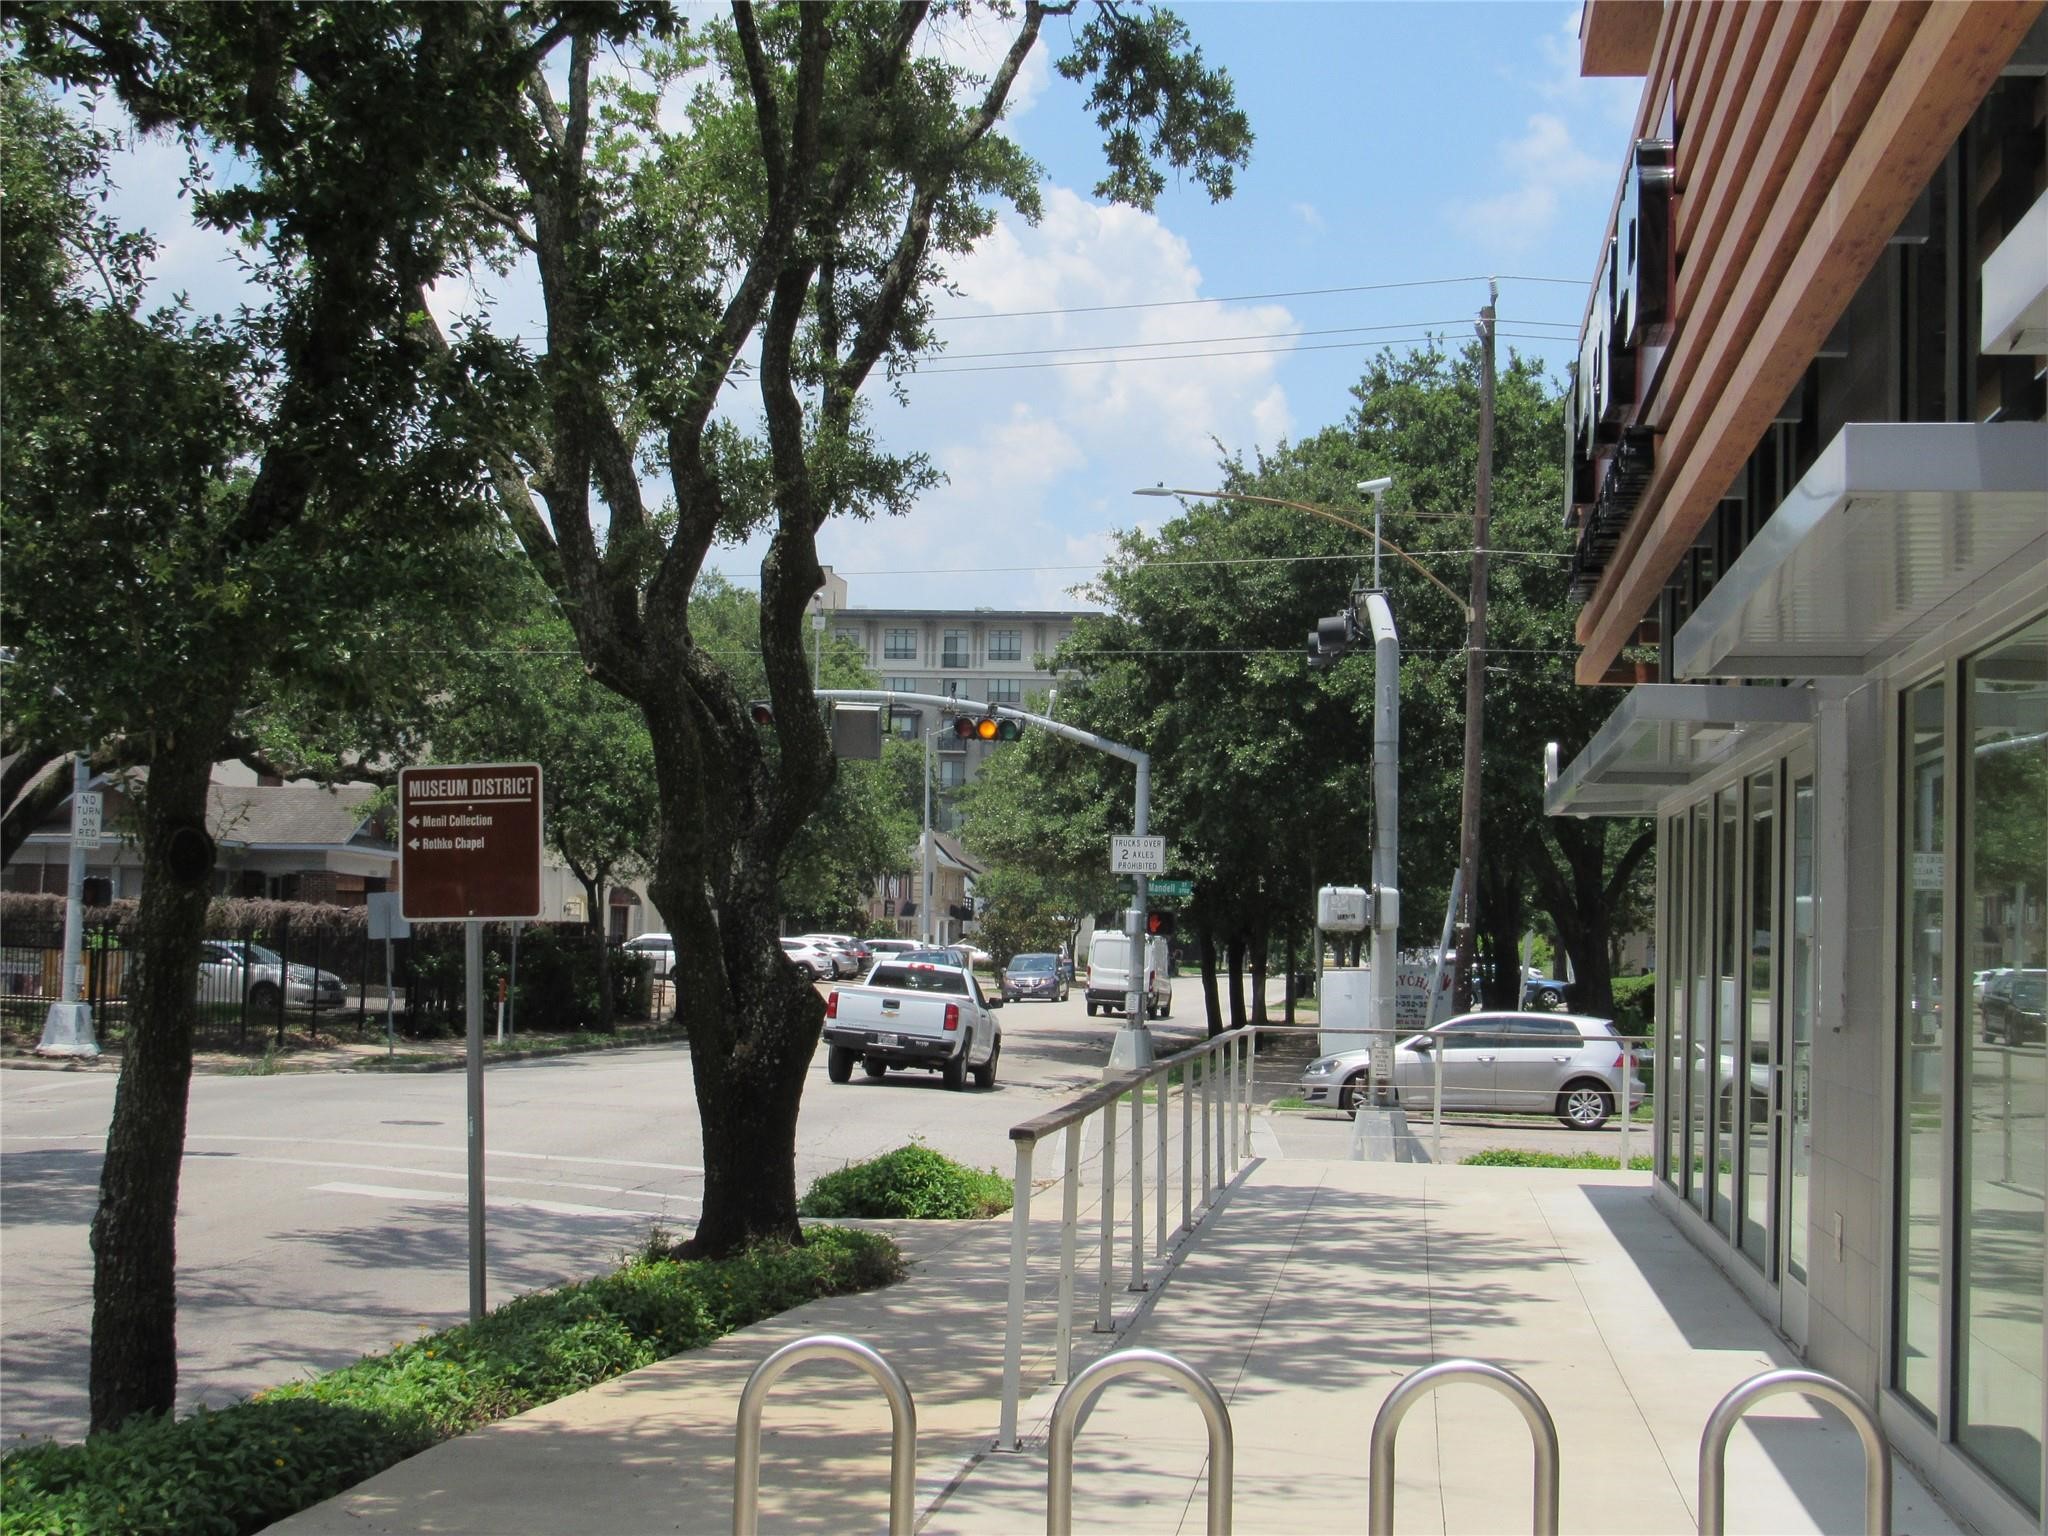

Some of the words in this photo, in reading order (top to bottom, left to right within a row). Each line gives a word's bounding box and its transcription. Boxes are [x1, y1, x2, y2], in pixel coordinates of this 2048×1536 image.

[409, 779, 468, 798] MUSEUM
[472, 777, 534, 796] DISTRICT
[82, 795, 96, 805] NO
[77, 806, 101, 815] TURN
[82, 817, 95, 826] ON
[422, 815, 447, 828] Menil
[449, 814, 493, 827] Collection
[79, 829, 97, 838] RED
[422, 837, 453, 850] Rothko
[455, 836, 485, 851] Chapel
[1115, 839, 1140, 848] TRUCKS
[1143, 840, 1161, 848] OVER
[1121, 849, 1129, 860] 2
[1132, 850, 1154, 859] AXLES
[1118, 862, 1157, 870] PROHIBITED
[1148, 882, 1176, 893] Mandell
